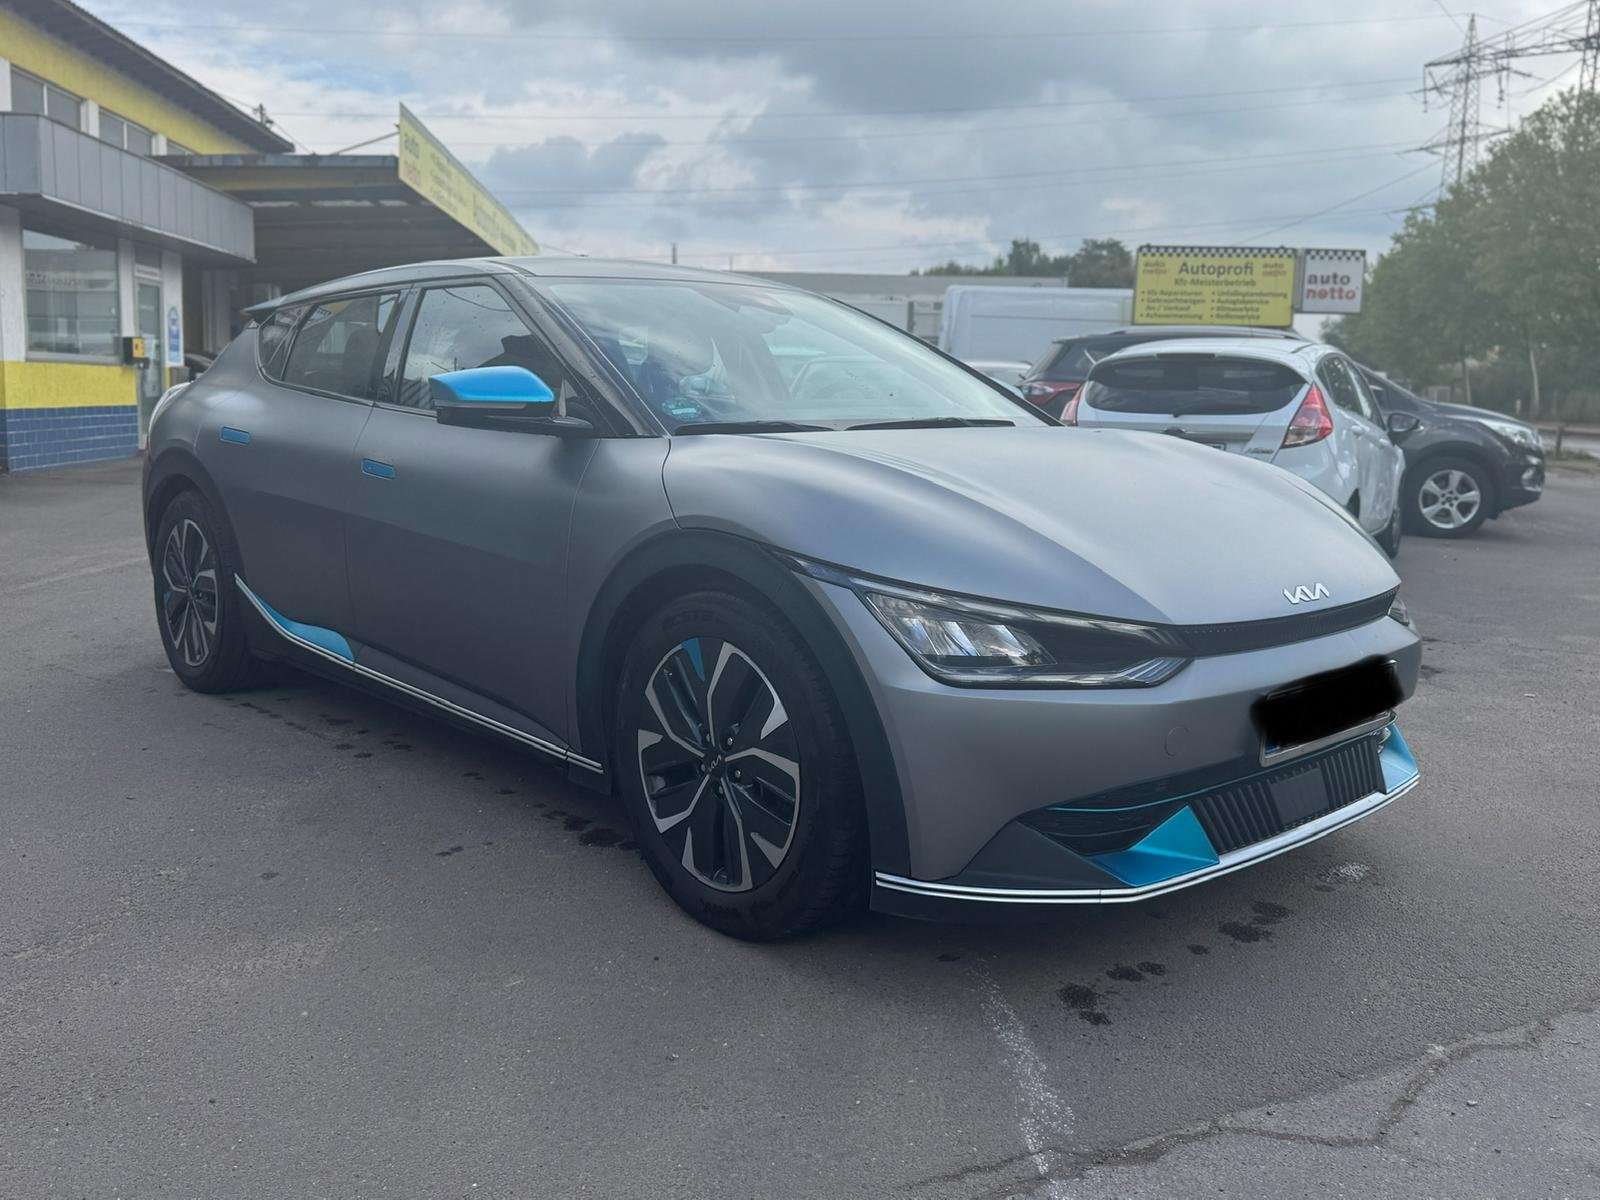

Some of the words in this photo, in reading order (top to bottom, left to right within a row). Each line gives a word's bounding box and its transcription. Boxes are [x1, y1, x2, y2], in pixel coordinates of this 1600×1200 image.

[1178, 261, 1254, 278] Autoprofi
[1307, 272, 1350, 285] auto
[1306, 287, 1356, 300] netto
[1283, 582, 1330, 604] KIA
